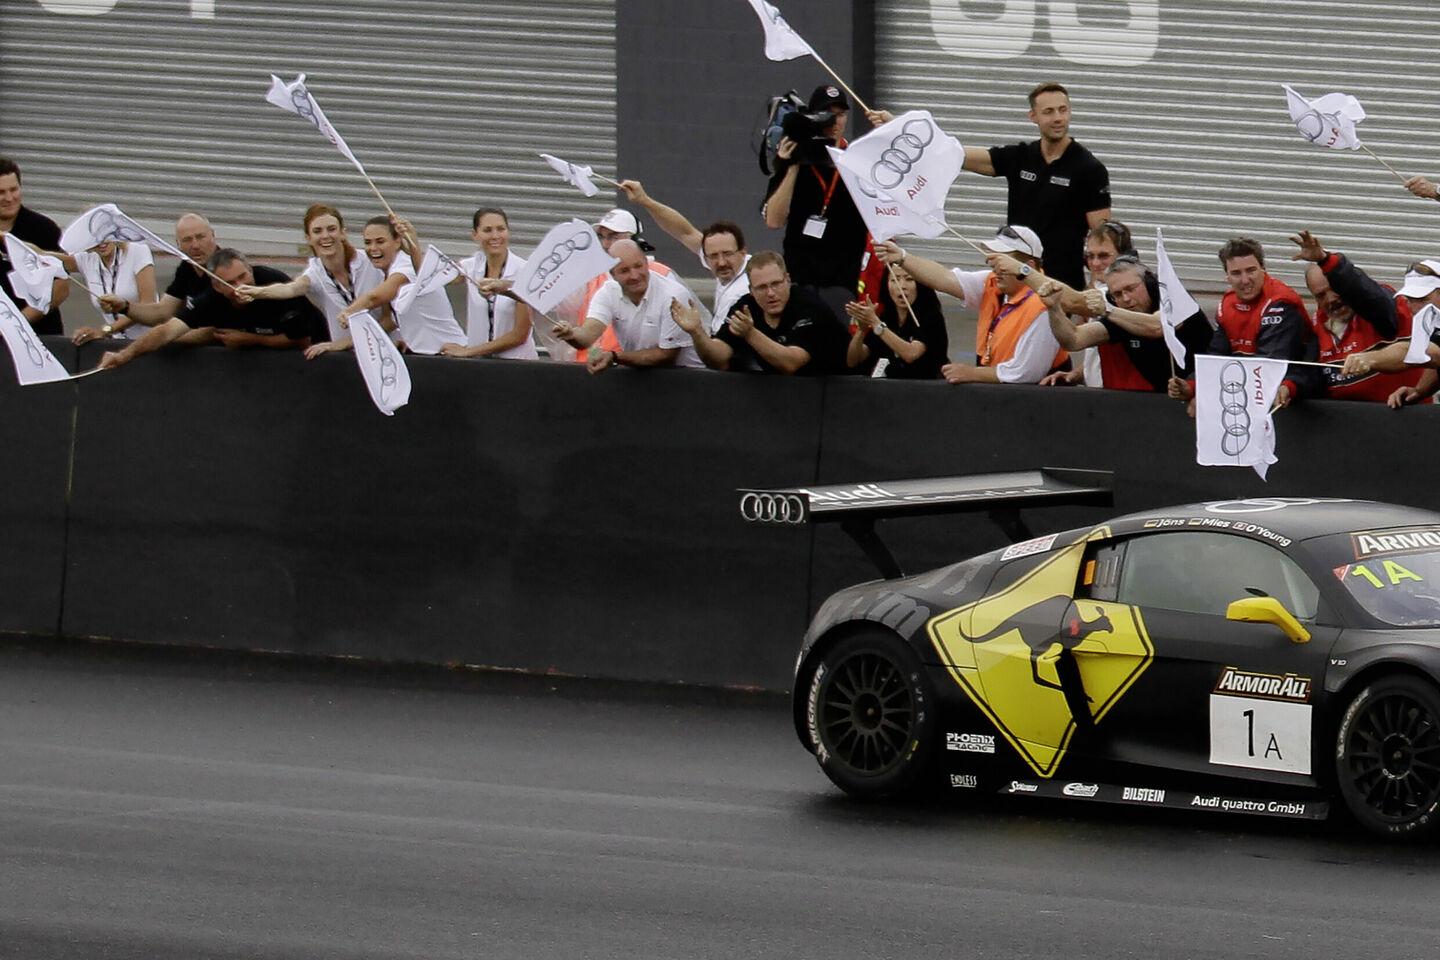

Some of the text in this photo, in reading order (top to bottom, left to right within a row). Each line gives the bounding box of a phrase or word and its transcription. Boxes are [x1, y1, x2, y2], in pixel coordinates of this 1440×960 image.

[907, 174, 928, 201] Audi
[799, 483, 896, 503] Audi
[1202, 518, 1231, 528] Mies
[1245, 524, 1292, 547] O'Young
[1351, 559, 1423, 589] 1A
[1219, 670, 1307, 698] ARMORALL
[946, 732, 995, 745] PHOENIX
[1243, 709, 1283, 761] 1 A
[950, 773, 977, 786] ENDLESS
[1122, 786, 1166, 803] BILSTEIN
[1191, 794, 1305, 815] Audi quattro GmbH
